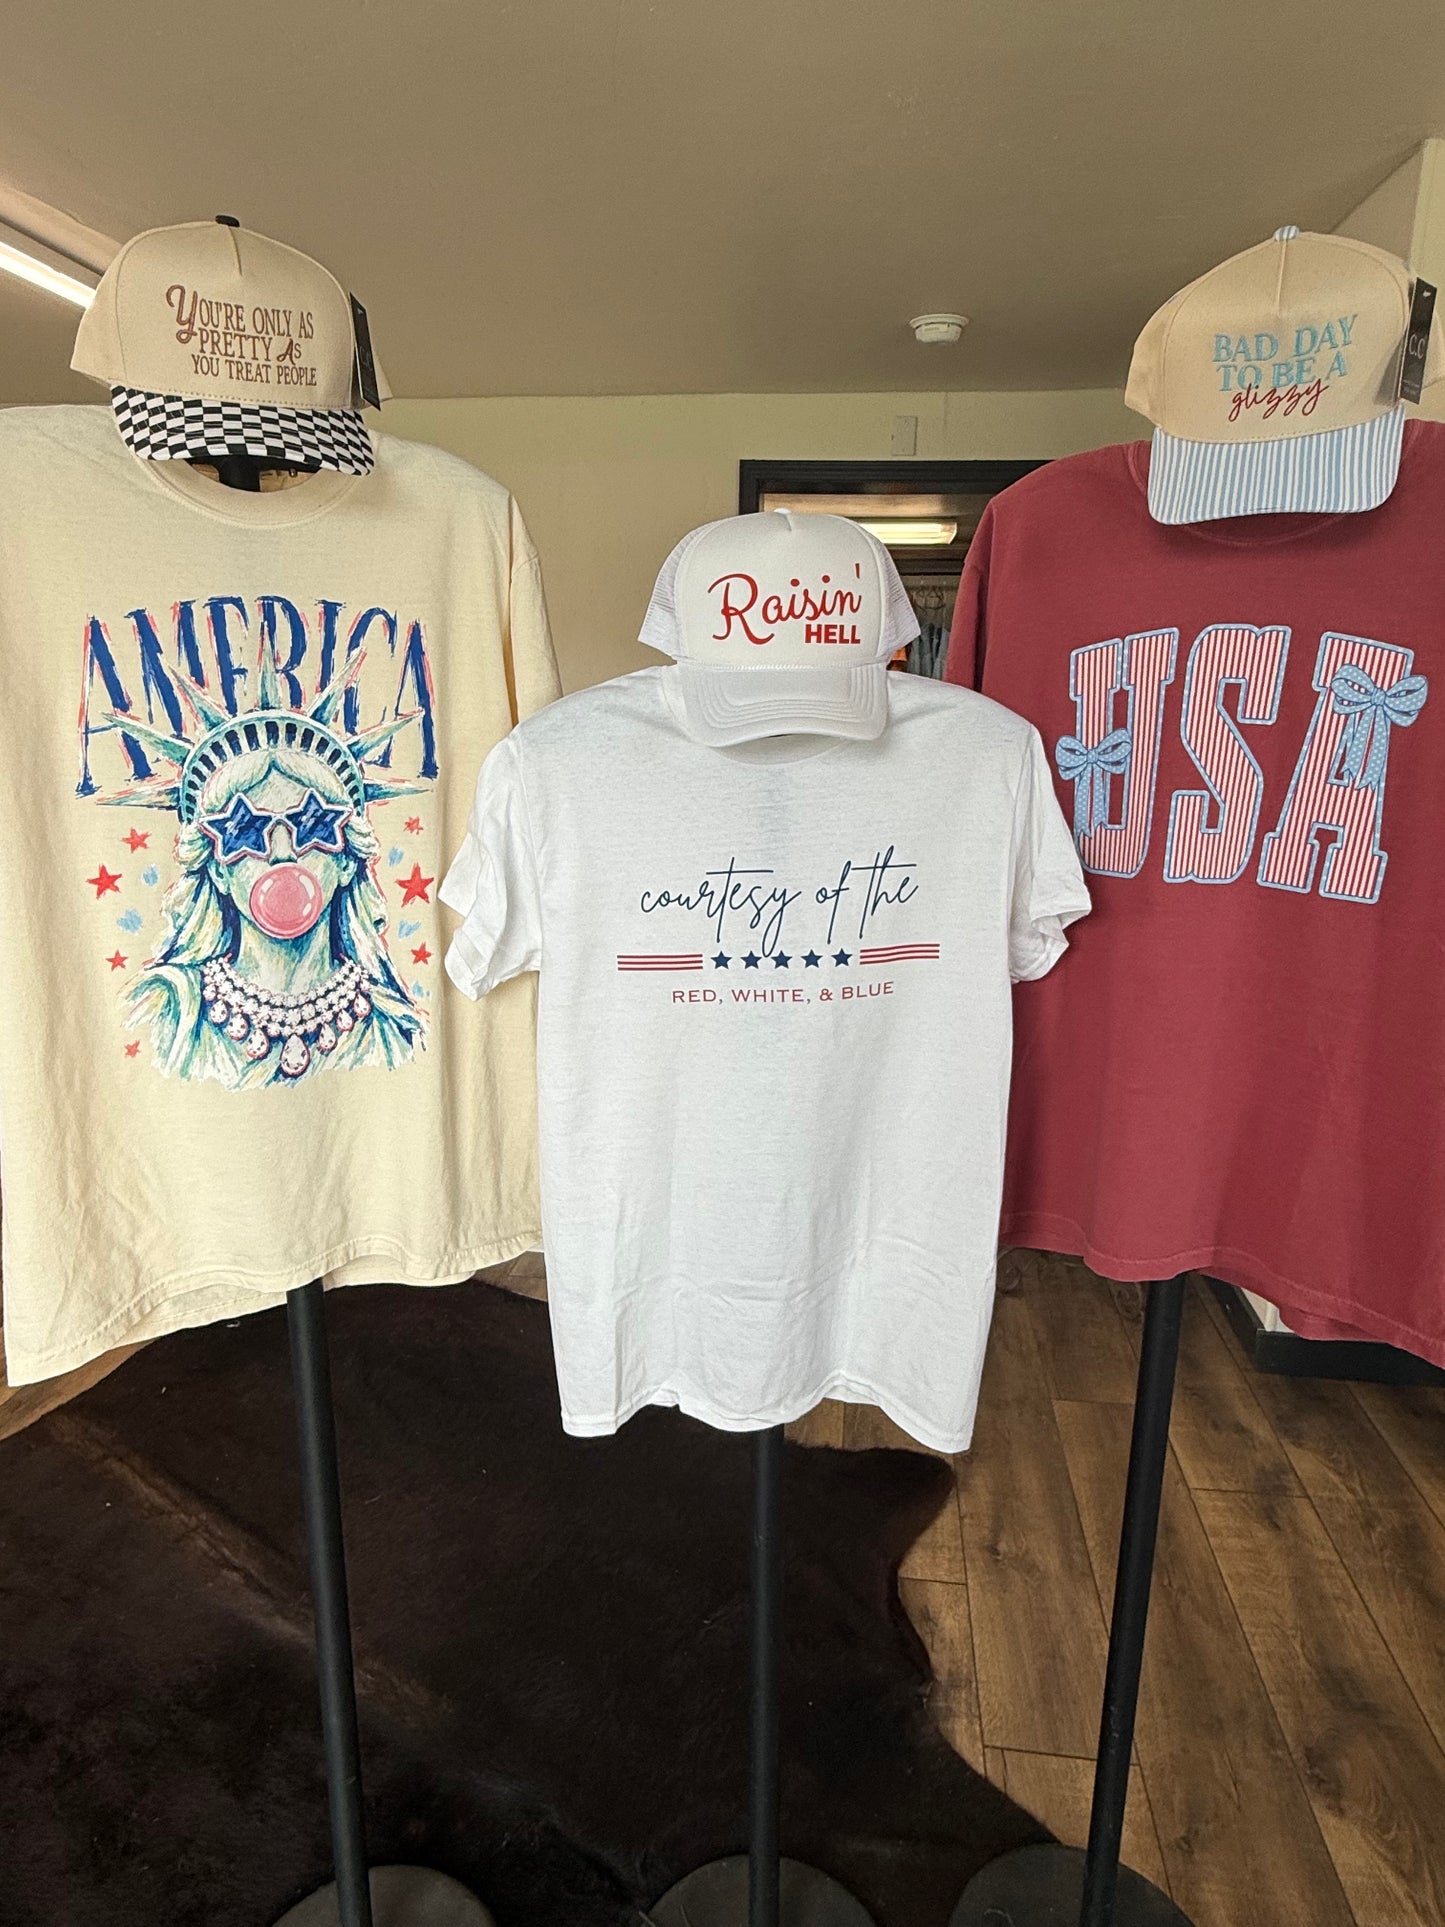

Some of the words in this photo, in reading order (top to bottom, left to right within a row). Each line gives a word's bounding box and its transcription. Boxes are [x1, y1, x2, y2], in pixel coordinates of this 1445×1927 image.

[252, 307, 292, 337] ONLY
[298, 311, 314, 339] AS
[1212, 333, 1279, 362] BAD
[1294, 314, 1358, 356] DAY
[198, 327, 272, 362] PRETTY
[191, 354, 220, 377] YOU
[225, 360, 271, 384] TREAT
[277, 364, 317, 386] PEOPLE
[1217, 364, 1262, 392] TO
[1271, 358, 1318, 389] BE
[1326, 351, 1347, 380] A
[1228, 378, 1329, 422] glizzy
[707, 563, 862, 645] Raisin'
[805, 624, 861, 644] HELL
[75, 595, 439, 797] AMERICA
[1069, 623, 1415, 904] USA
[641, 857, 802, 958] courtesy
[815, 860, 851, 945] of
[851, 845, 919, 939] the
[672, 989, 723, 1004] RED,
[732, 988, 811, 1004] WHITE,
[819, 988, 833, 1001] &
[842, 981, 894, 1001] BLUE
